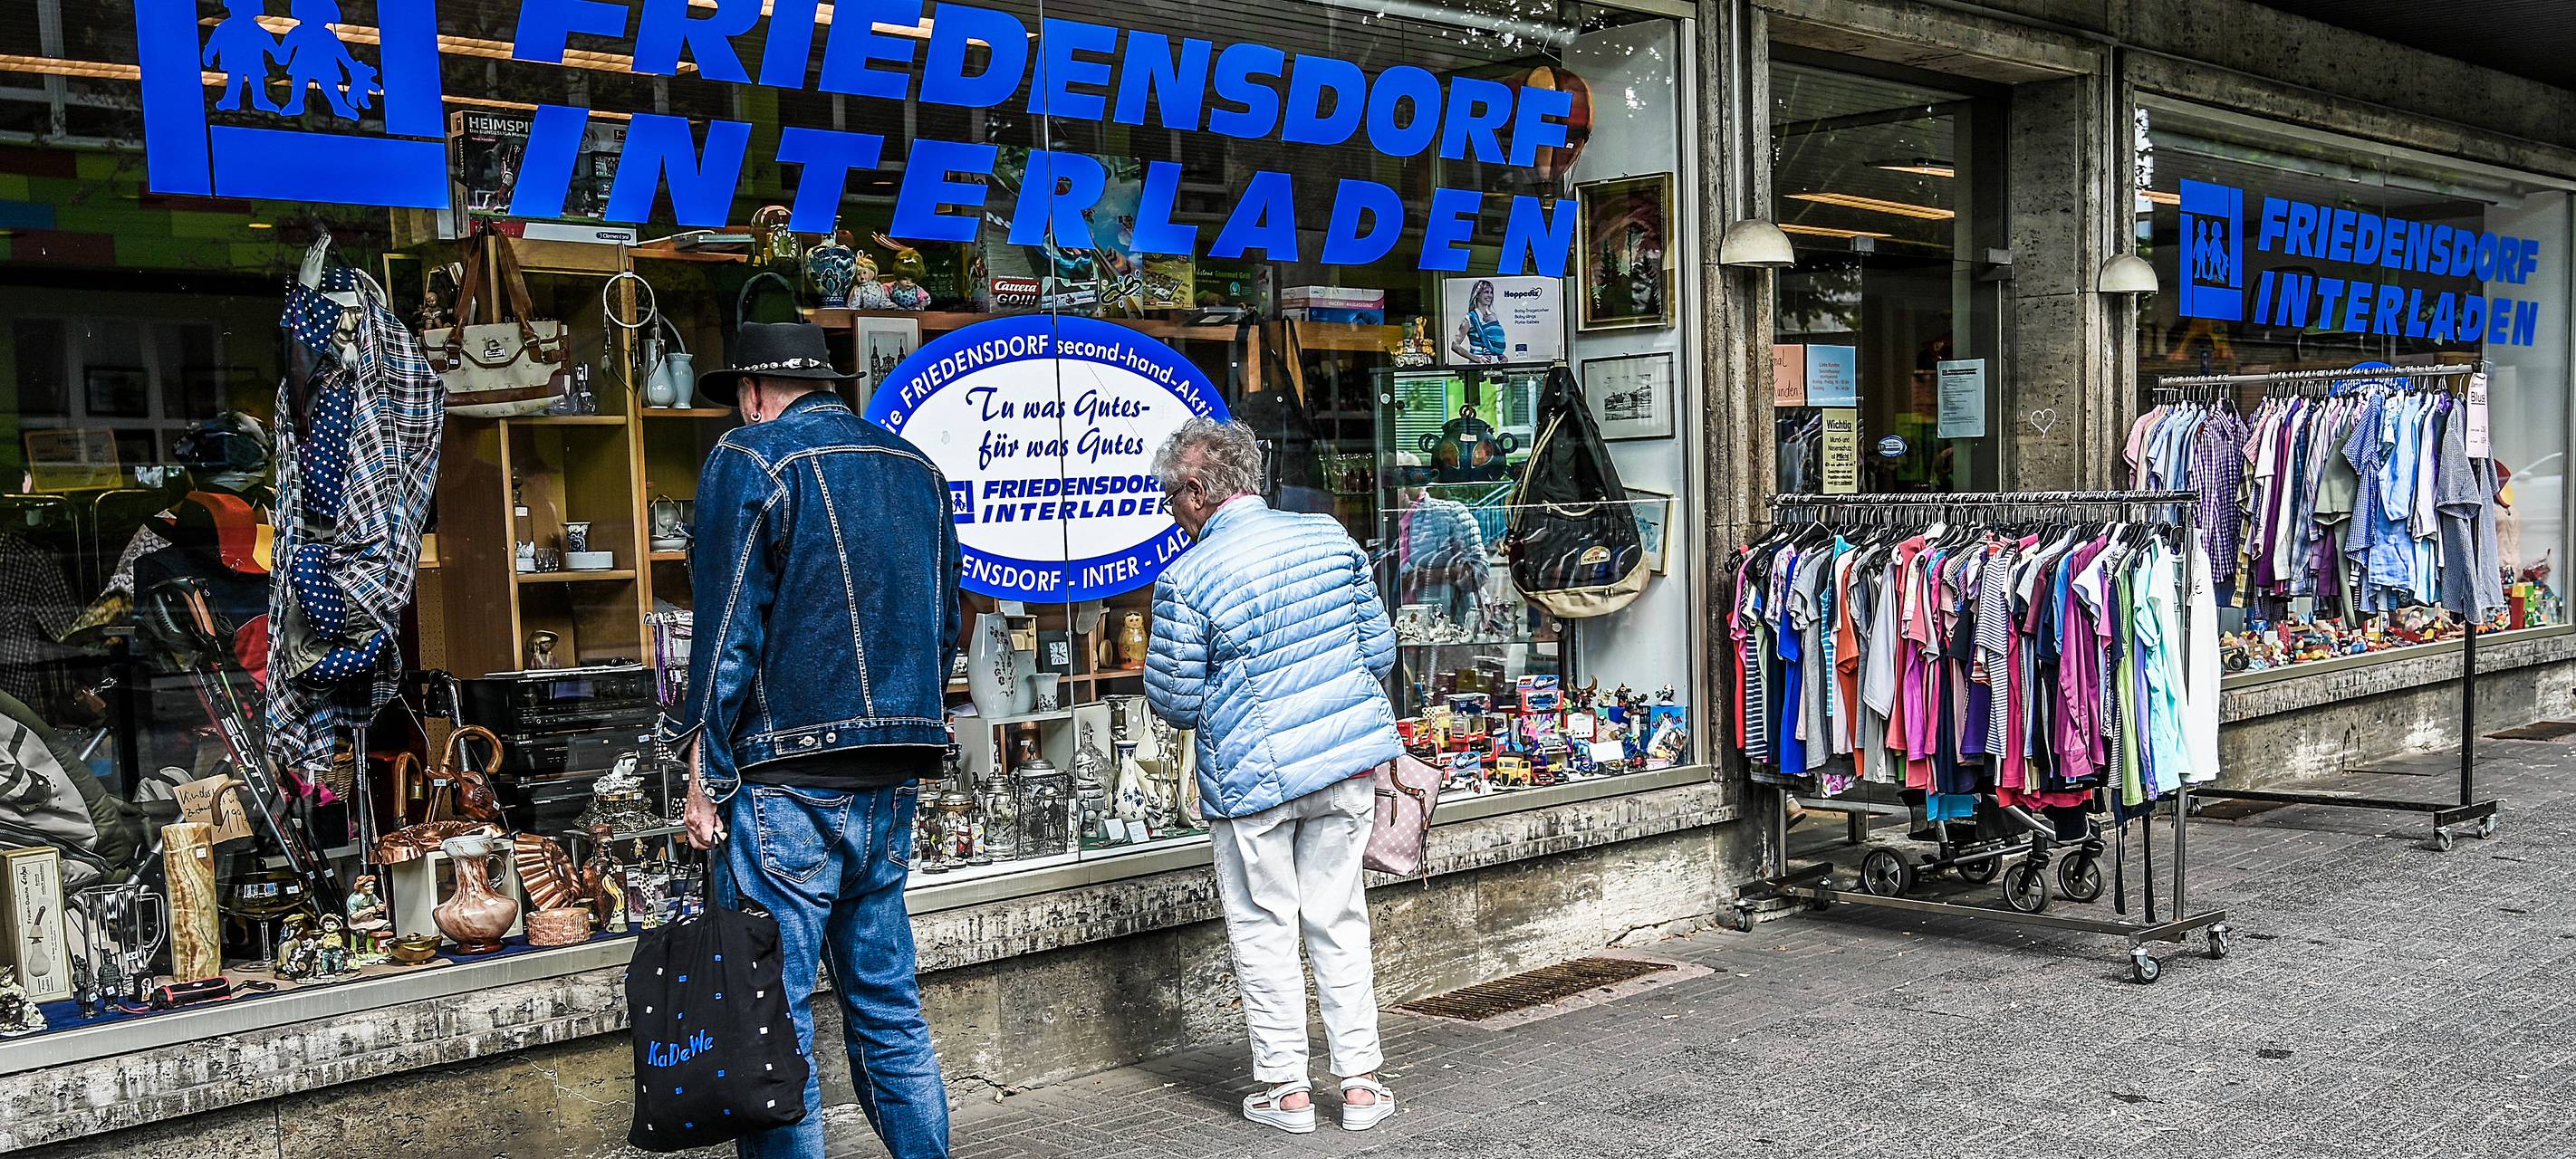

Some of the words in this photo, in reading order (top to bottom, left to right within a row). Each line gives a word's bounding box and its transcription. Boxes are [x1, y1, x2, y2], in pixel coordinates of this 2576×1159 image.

[512, 0, 1572, 167] FRIEDENSDORF
[468, 117, 533, 133] HEIMSPI
[508, 103, 1579, 277] INTERLADEN
[2257, 196, 2539, 285] FRIEDENSDORF
[995, 281, 1038, 293] Carrera
[996, 293, 1036, 305] GO!!!
[2254, 270, 2539, 347] INTERLADEN
[879, 409, 904, 435] ie
[899, 334, 1049, 409] FRIEDENSDORF
[1056, 339, 1214, 418] second-hand-Akti
[966, 387, 1014, 422] Tu
[1024, 399, 1065, 419] was
[1073, 389, 1150, 426] Gutes-
[978, 430, 1019, 471] für
[1026, 437, 1069, 458] was
[1077, 427, 1144, 465] Gutes
[1826, 420, 1851, 432] Wichtig
[961, 553, 1062, 592] ENSDORF
[1082, 556, 1140, 589] INTER
[1155, 526, 1192, 563] LAD
[220, 716, 272, 796] SCOTT
[647, 1029, 714, 1068] KaDeWe
